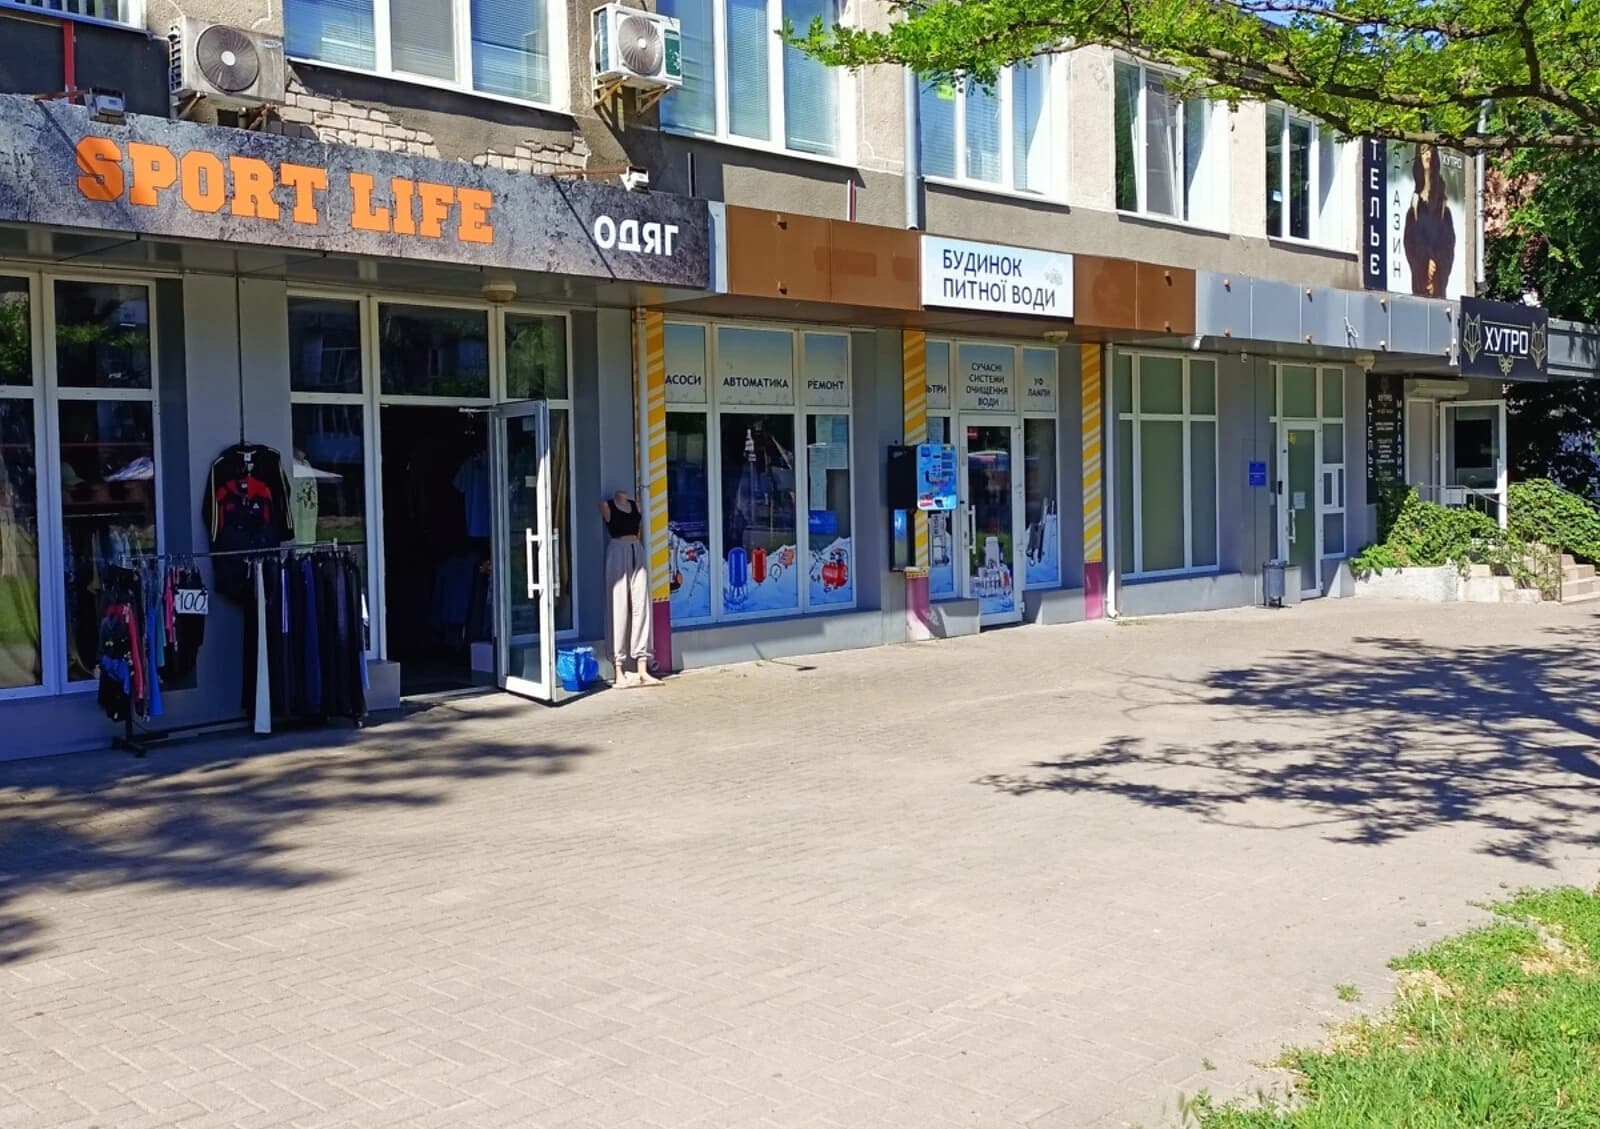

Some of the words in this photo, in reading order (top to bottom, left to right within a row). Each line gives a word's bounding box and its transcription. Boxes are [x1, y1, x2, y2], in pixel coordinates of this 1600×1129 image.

[76, 135, 328, 225] SPORT
[349, 172, 495, 244] LIFE
[1370, 139, 1380, 276] ТЕЛЬЄ
[1392, 145, 1402, 278] АГАЗИН
[594, 215, 679, 256] ОДЯГ
[943, 249, 1022, 277] БУДИНОК
[943, 277, 1007, 303] ПИТНОЇ
[1012, 284, 1056, 311] ВОДИ
[1484, 326, 1529, 355] ХУТРО
[664, 374, 702, 386] АСОСИ
[723, 376, 789, 389] АВТОМАТИКА
[807, 380, 845, 391] РЕМОНТ
[926, 384, 946, 394] ЬТРИ
[968, 373, 1005, 385] СИСТЕМИ
[965, 385, 1008, 397] ОЧИЩЕННЯ
[977, 397, 1000, 408] ВОДИ
[180, 590, 206, 611] 100
